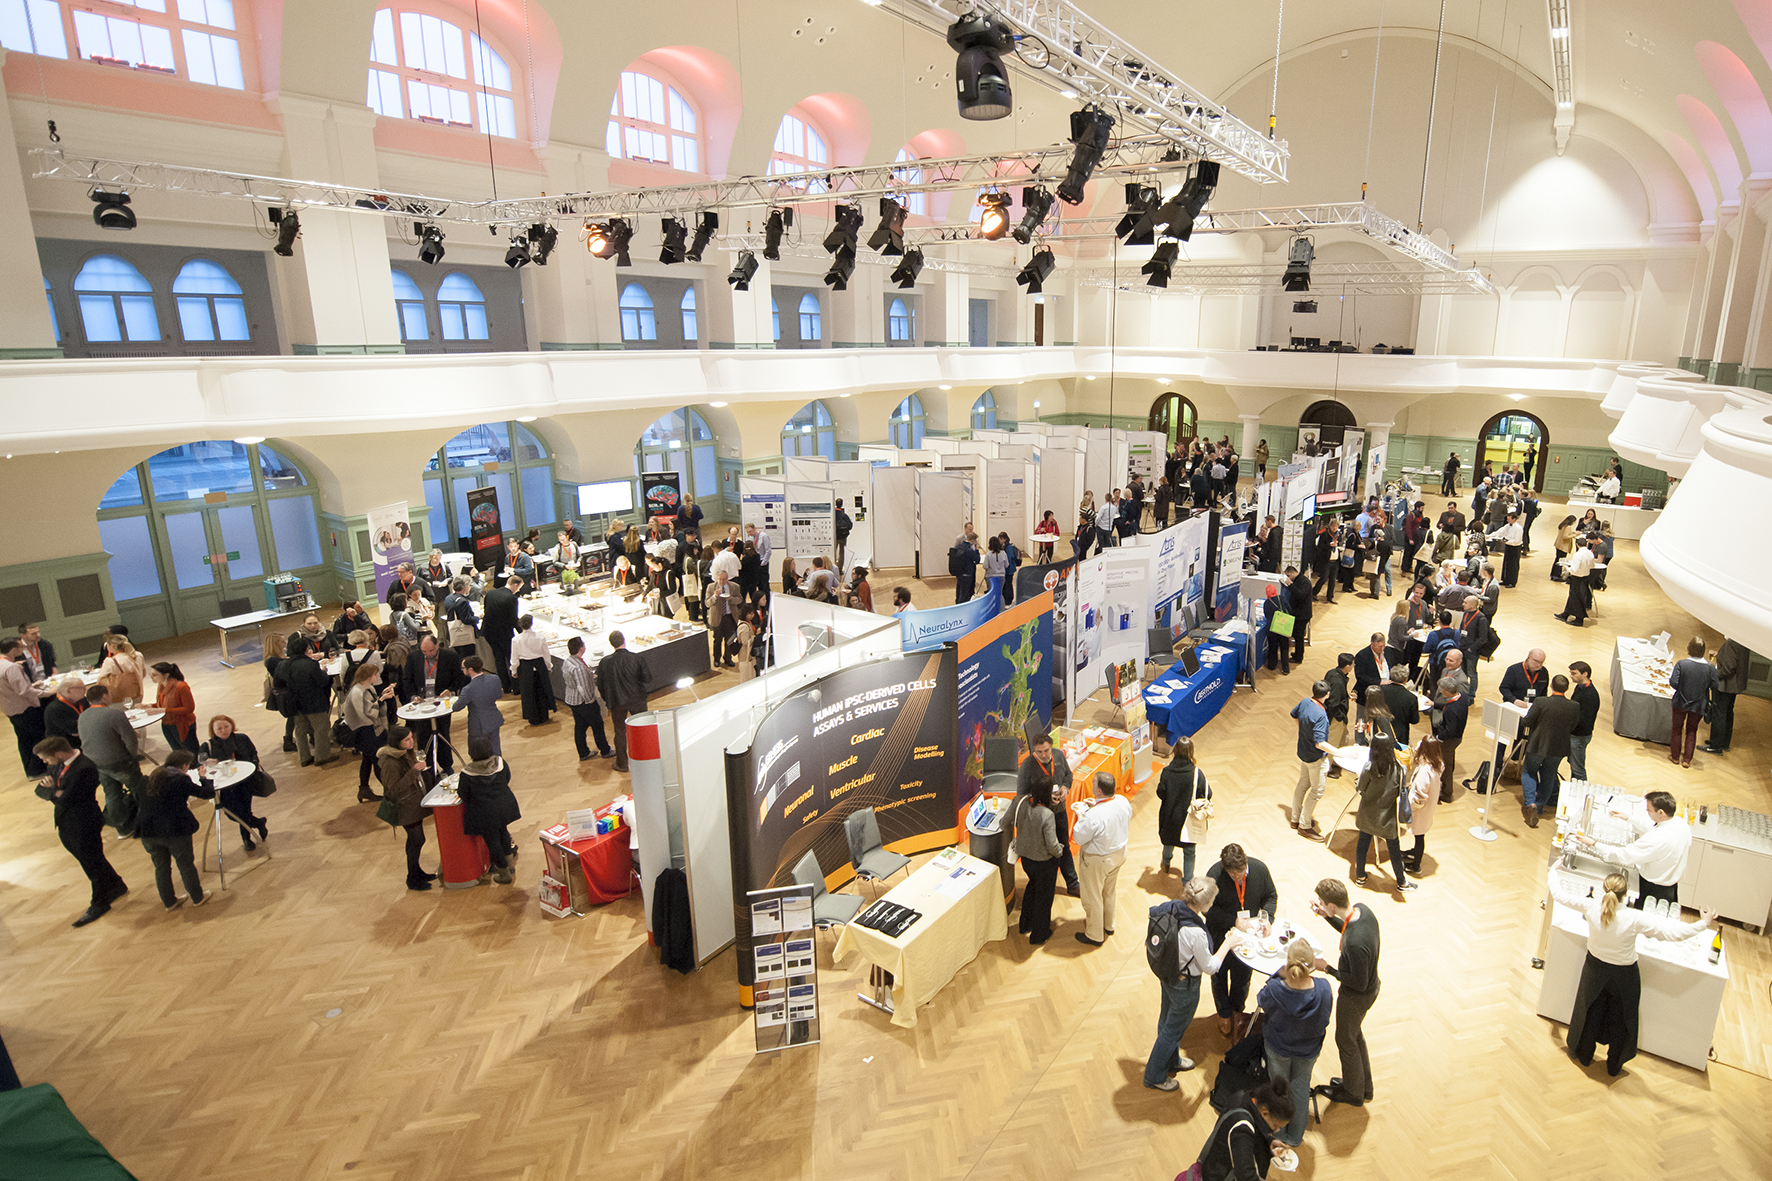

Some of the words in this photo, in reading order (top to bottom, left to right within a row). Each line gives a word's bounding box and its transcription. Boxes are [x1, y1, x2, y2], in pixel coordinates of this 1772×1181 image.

[812, 701, 844, 723] HUMAN
[907, 678, 937, 692] CELLS
[813, 714, 845, 738] ASSAYS
[845, 711, 854, 721] &
[854, 697, 899, 719] SERVICES
[850, 727, 885, 746] Cardiac
[913, 744, 939, 754] Disease
[913, 750, 945, 760] Modelling
[828, 755, 859, 776] Muscle
[830, 772, 876, 800] Ventricular
[900, 780, 924, 791] Toxicity
[783, 784, 815, 819] Neuronal
[907, 792, 937, 804] screening
[802, 808, 819, 825] Safety
